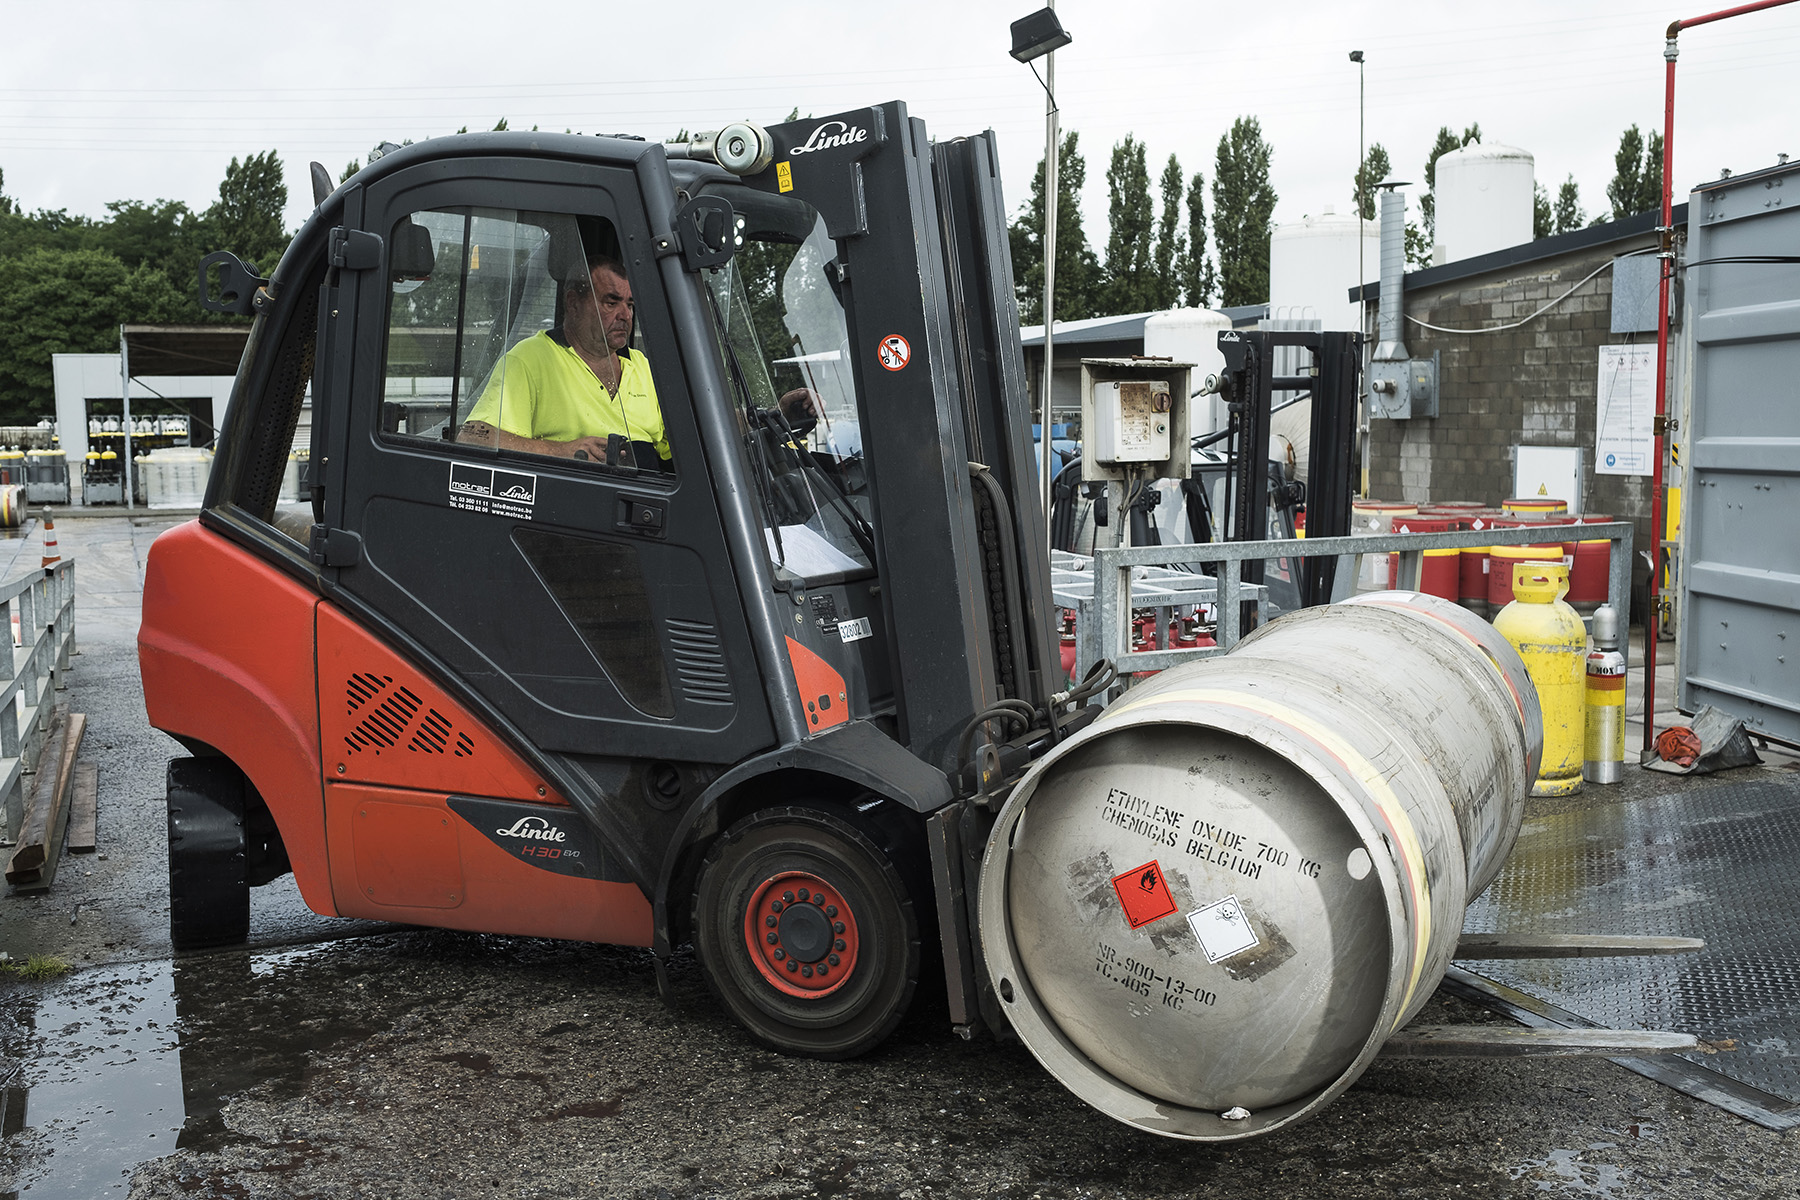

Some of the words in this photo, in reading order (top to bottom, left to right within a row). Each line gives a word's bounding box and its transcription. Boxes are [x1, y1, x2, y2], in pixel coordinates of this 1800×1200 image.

[790, 121, 868, 156] Linde
[452, 481, 490, 494] motrac
[500, 485, 532, 500] Linde
[492, 502, 532, 514] info@motrac.be
[492, 509, 532, 520] www.motrac.be
[1596, 666, 1615, 675] MOX
[496, 816, 566, 842] Linde
[1107, 788, 1184, 829] ETHYLENE
[1192, 820, 1247, 852] OXIDE
[1257, 842, 1289, 867] 700
[1298, 858, 1321, 879] KG
[1101, 806, 1178, 847] CHEMOGAS
[1185, 839, 1262, 880] BELGIUM
[1162, 992, 1184, 1011] KG
